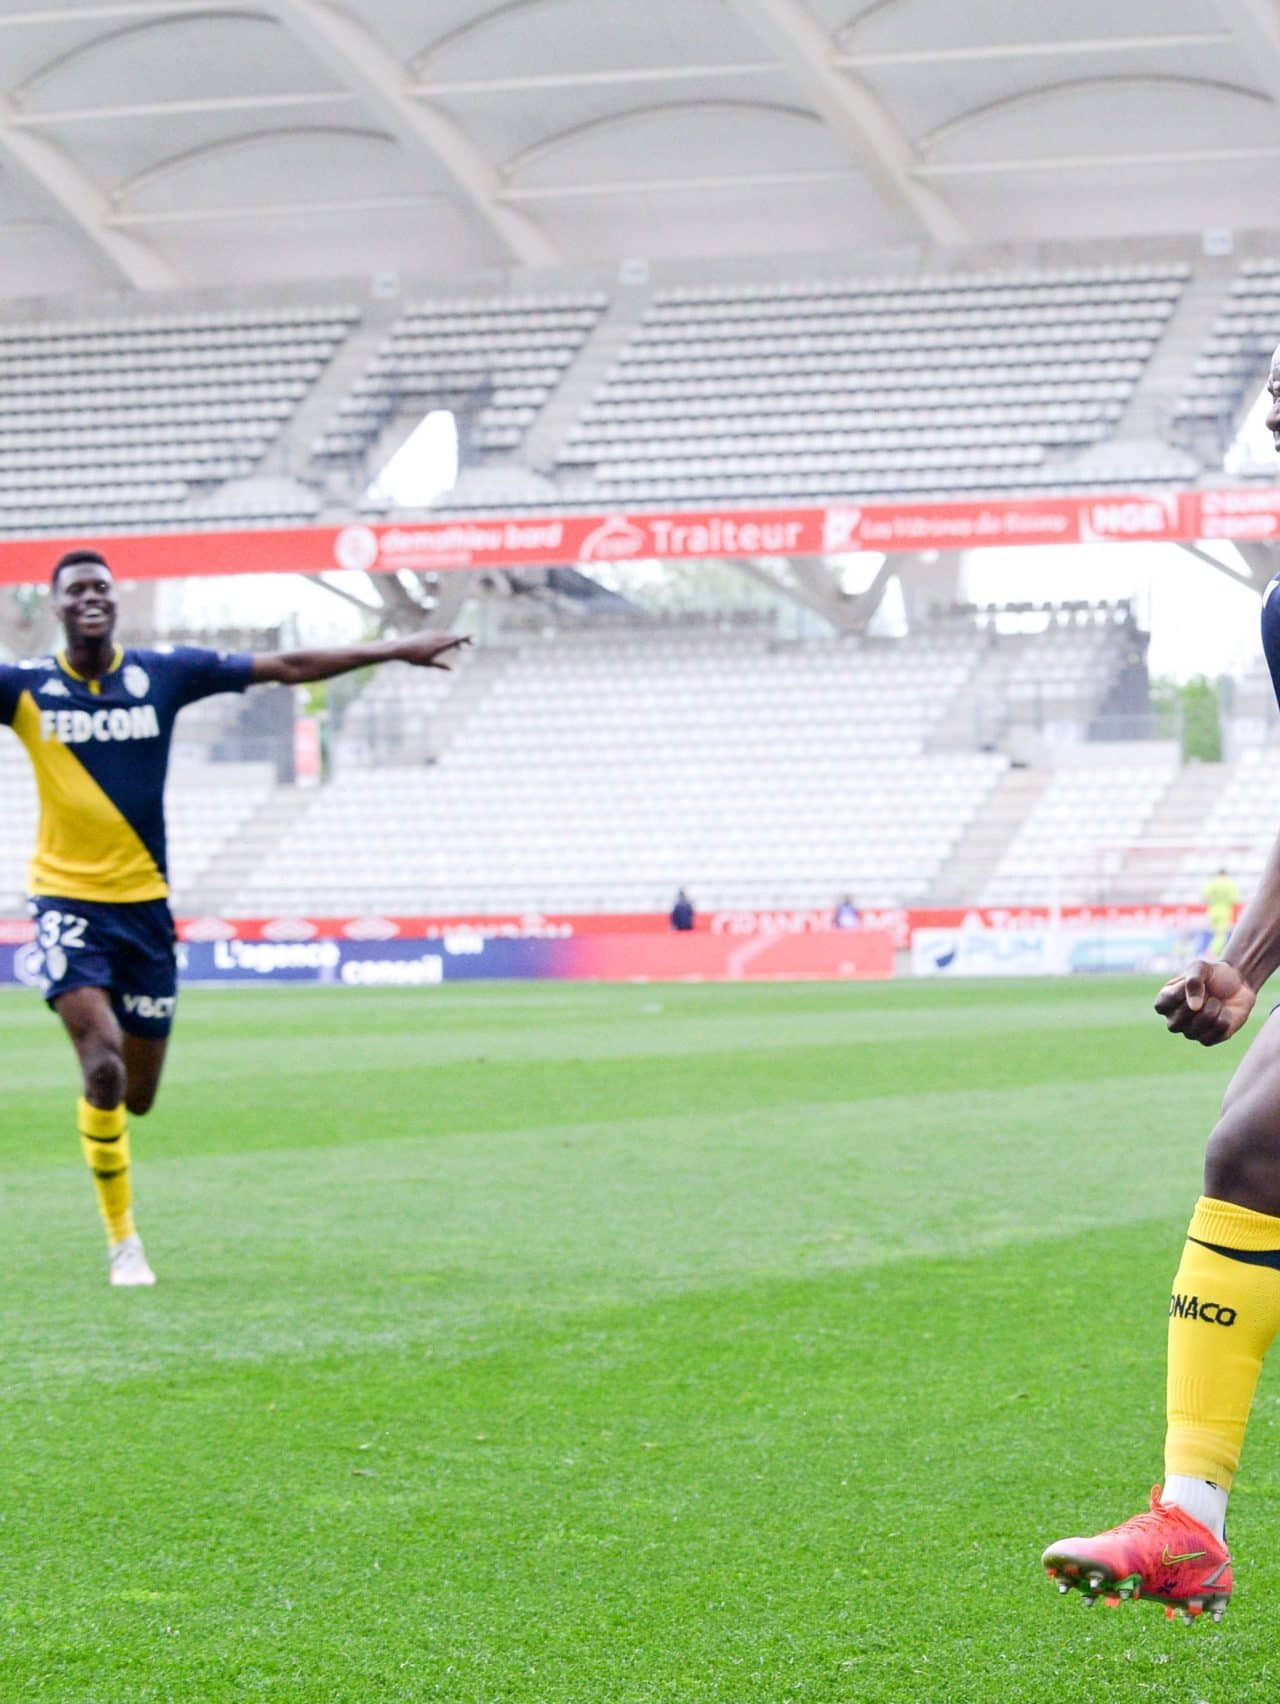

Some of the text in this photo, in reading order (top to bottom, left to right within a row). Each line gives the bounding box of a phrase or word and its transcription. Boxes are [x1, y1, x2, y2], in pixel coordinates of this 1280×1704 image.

[650, 518, 803, 554] Traiteur
[40, 704, 160, 744] FEDCOM
[1168, 1293, 1237, 1327] ONACO
